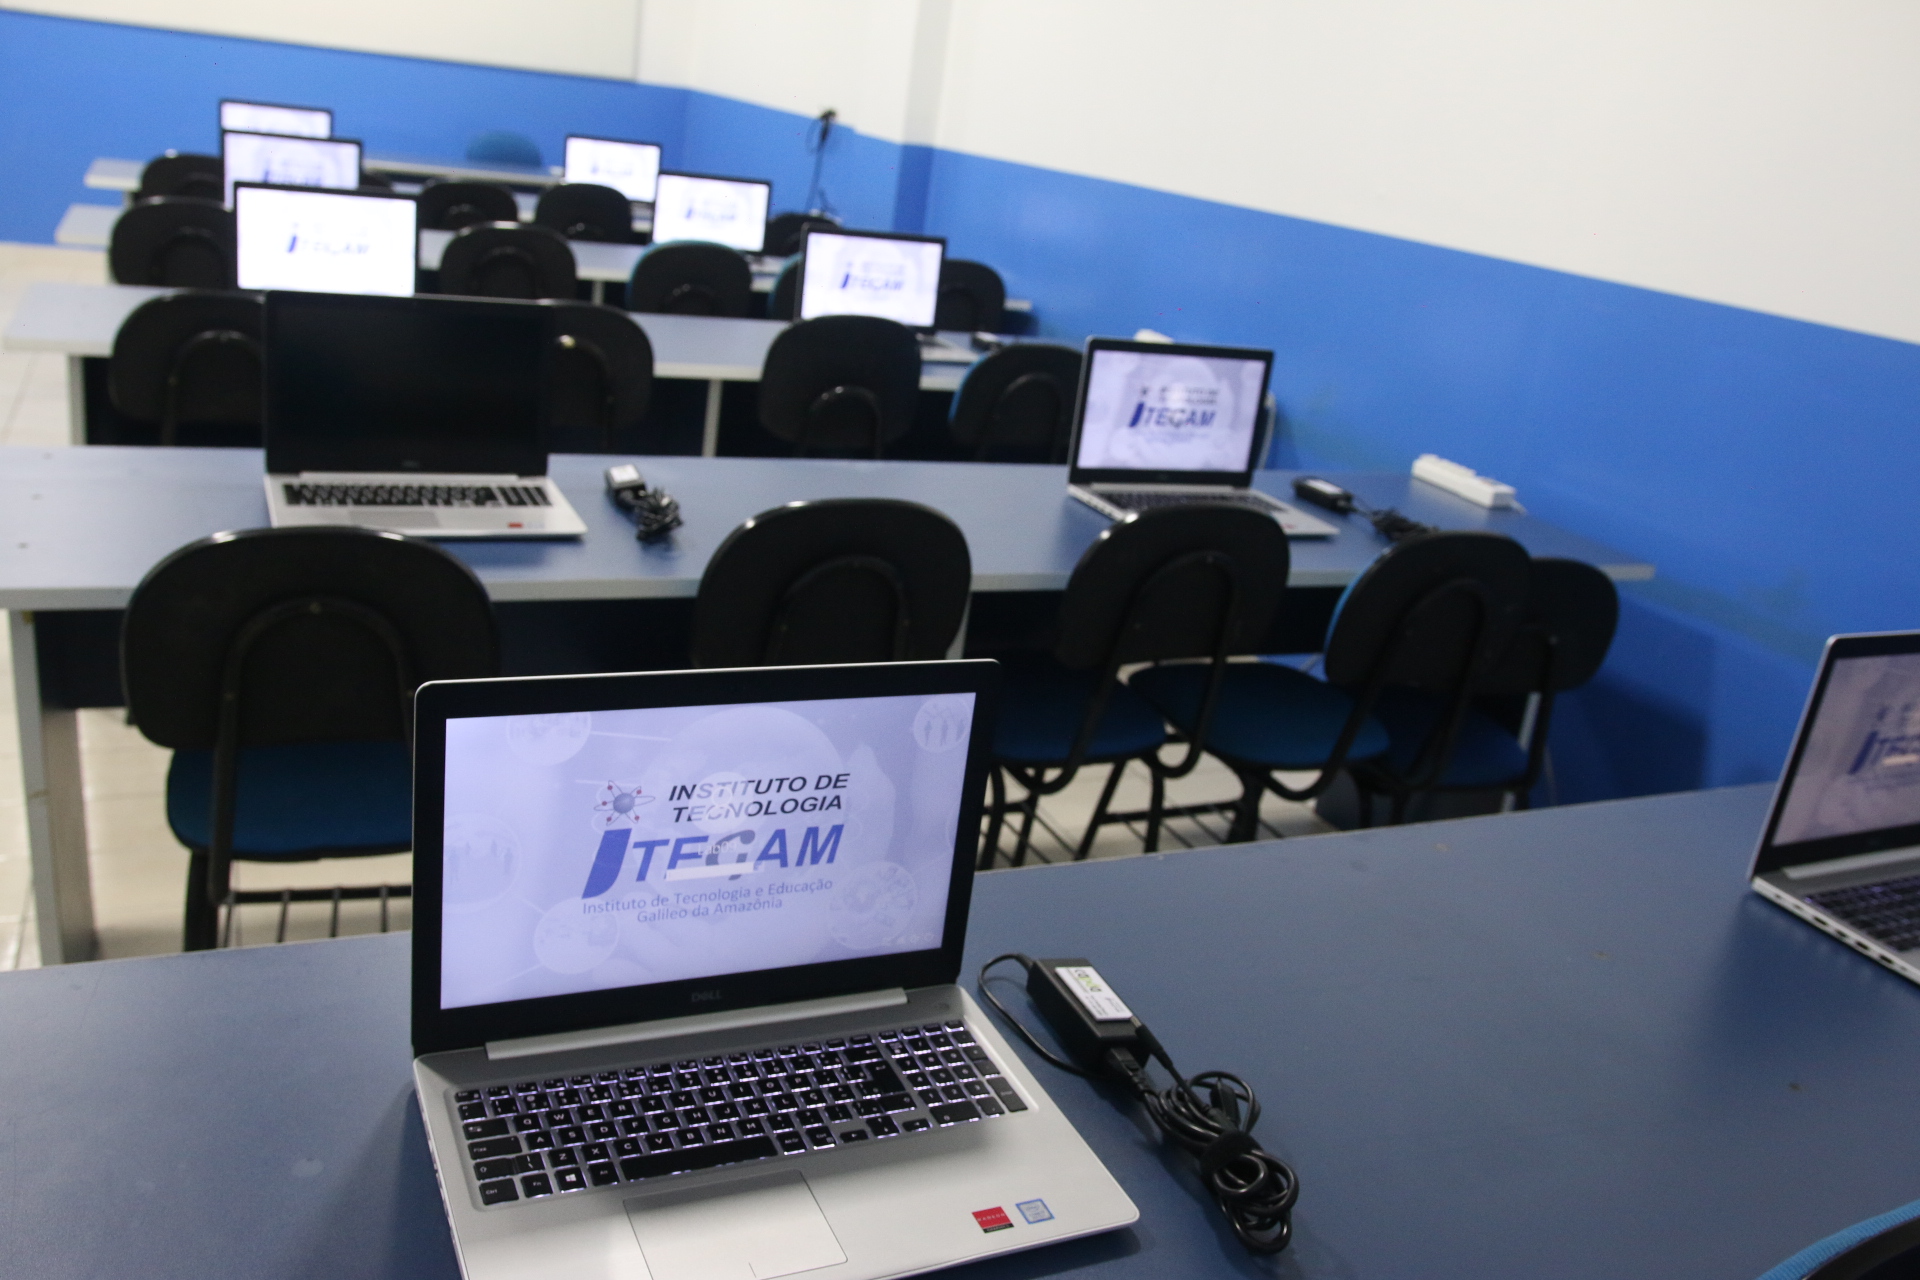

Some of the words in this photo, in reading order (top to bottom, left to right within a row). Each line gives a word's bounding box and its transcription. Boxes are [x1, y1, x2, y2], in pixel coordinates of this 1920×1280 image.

[668, 776, 807, 802] INSTITUTO
[814, 773, 851, 791] DE
[672, 794, 843, 824] TECNOLOGIA
[582, 896, 647, 915] Instituto
[651, 894, 670, 907] de
[674, 888, 751, 905] Tecnologia
[755, 887, 765, 898] e
[768, 879, 833, 896] Educação
[637, 906, 688, 924] Galileo
[692, 904, 710, 917] da
[713, 898, 783, 916] Amazônia
